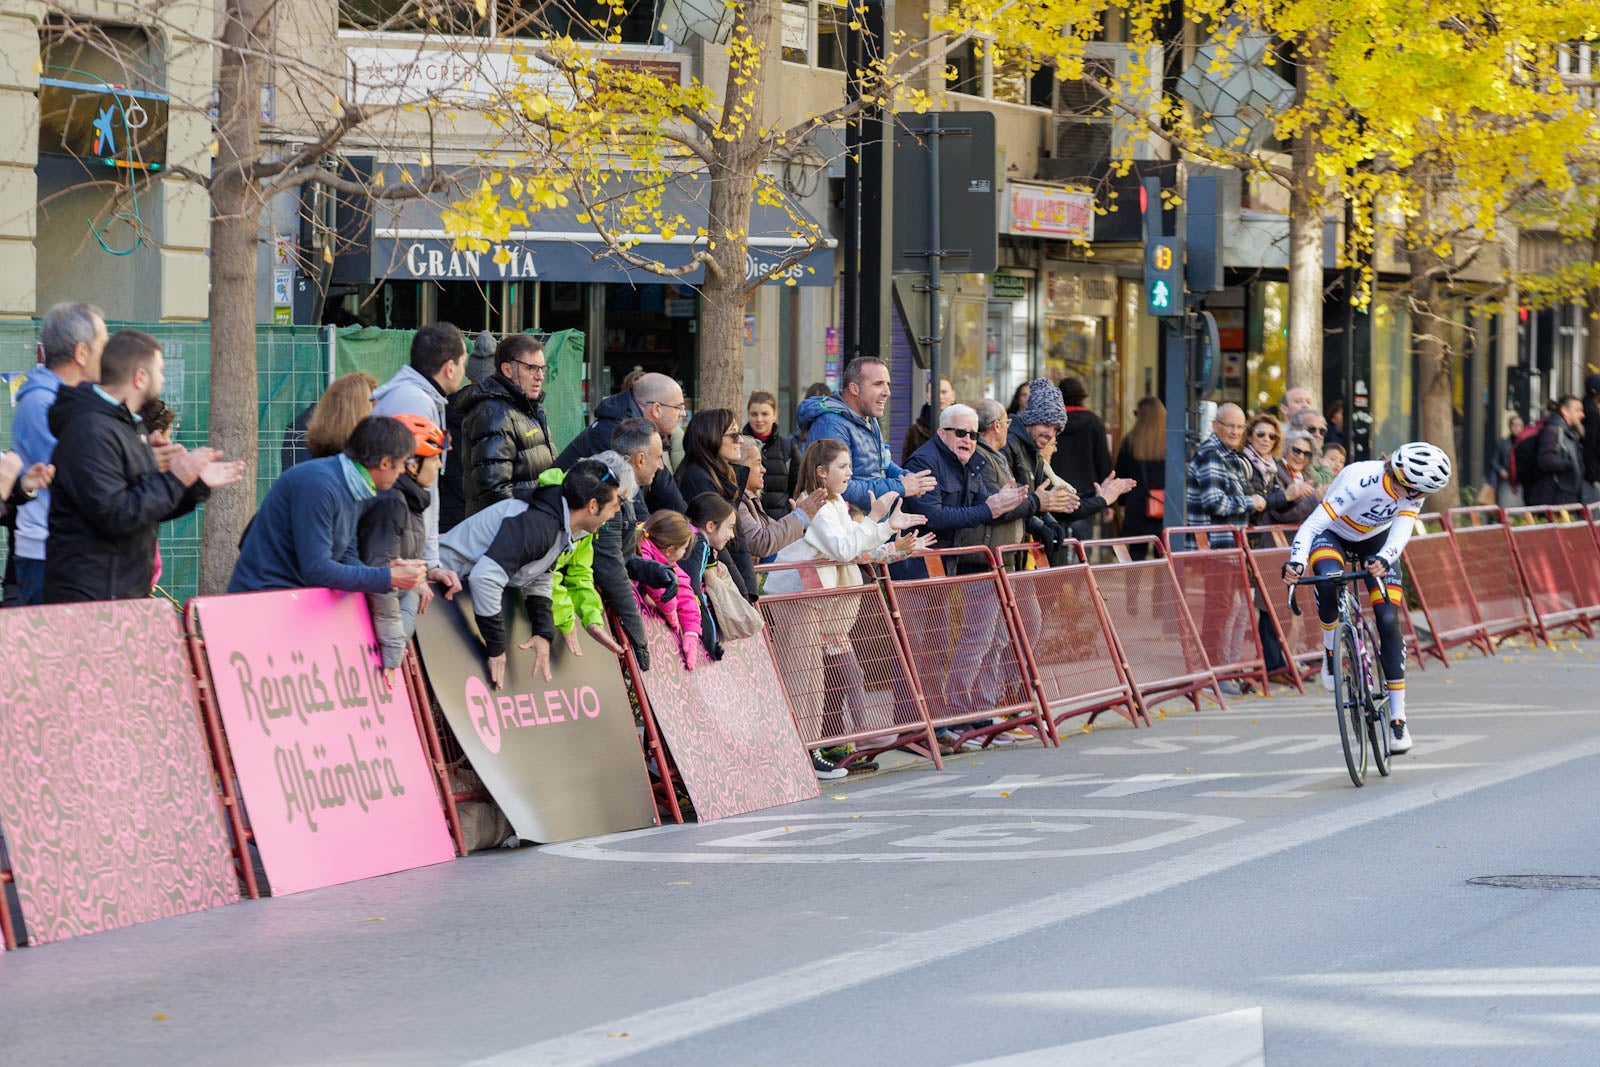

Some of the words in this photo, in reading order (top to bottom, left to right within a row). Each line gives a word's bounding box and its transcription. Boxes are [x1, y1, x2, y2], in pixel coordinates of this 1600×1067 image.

[407, 243, 480, 277] GRAN
[332, 644, 368, 709] de
[497, 685, 600, 729] RELEVO
[843, 773, 1349, 799] TAXI
[696, 822, 1094, 848] 30
